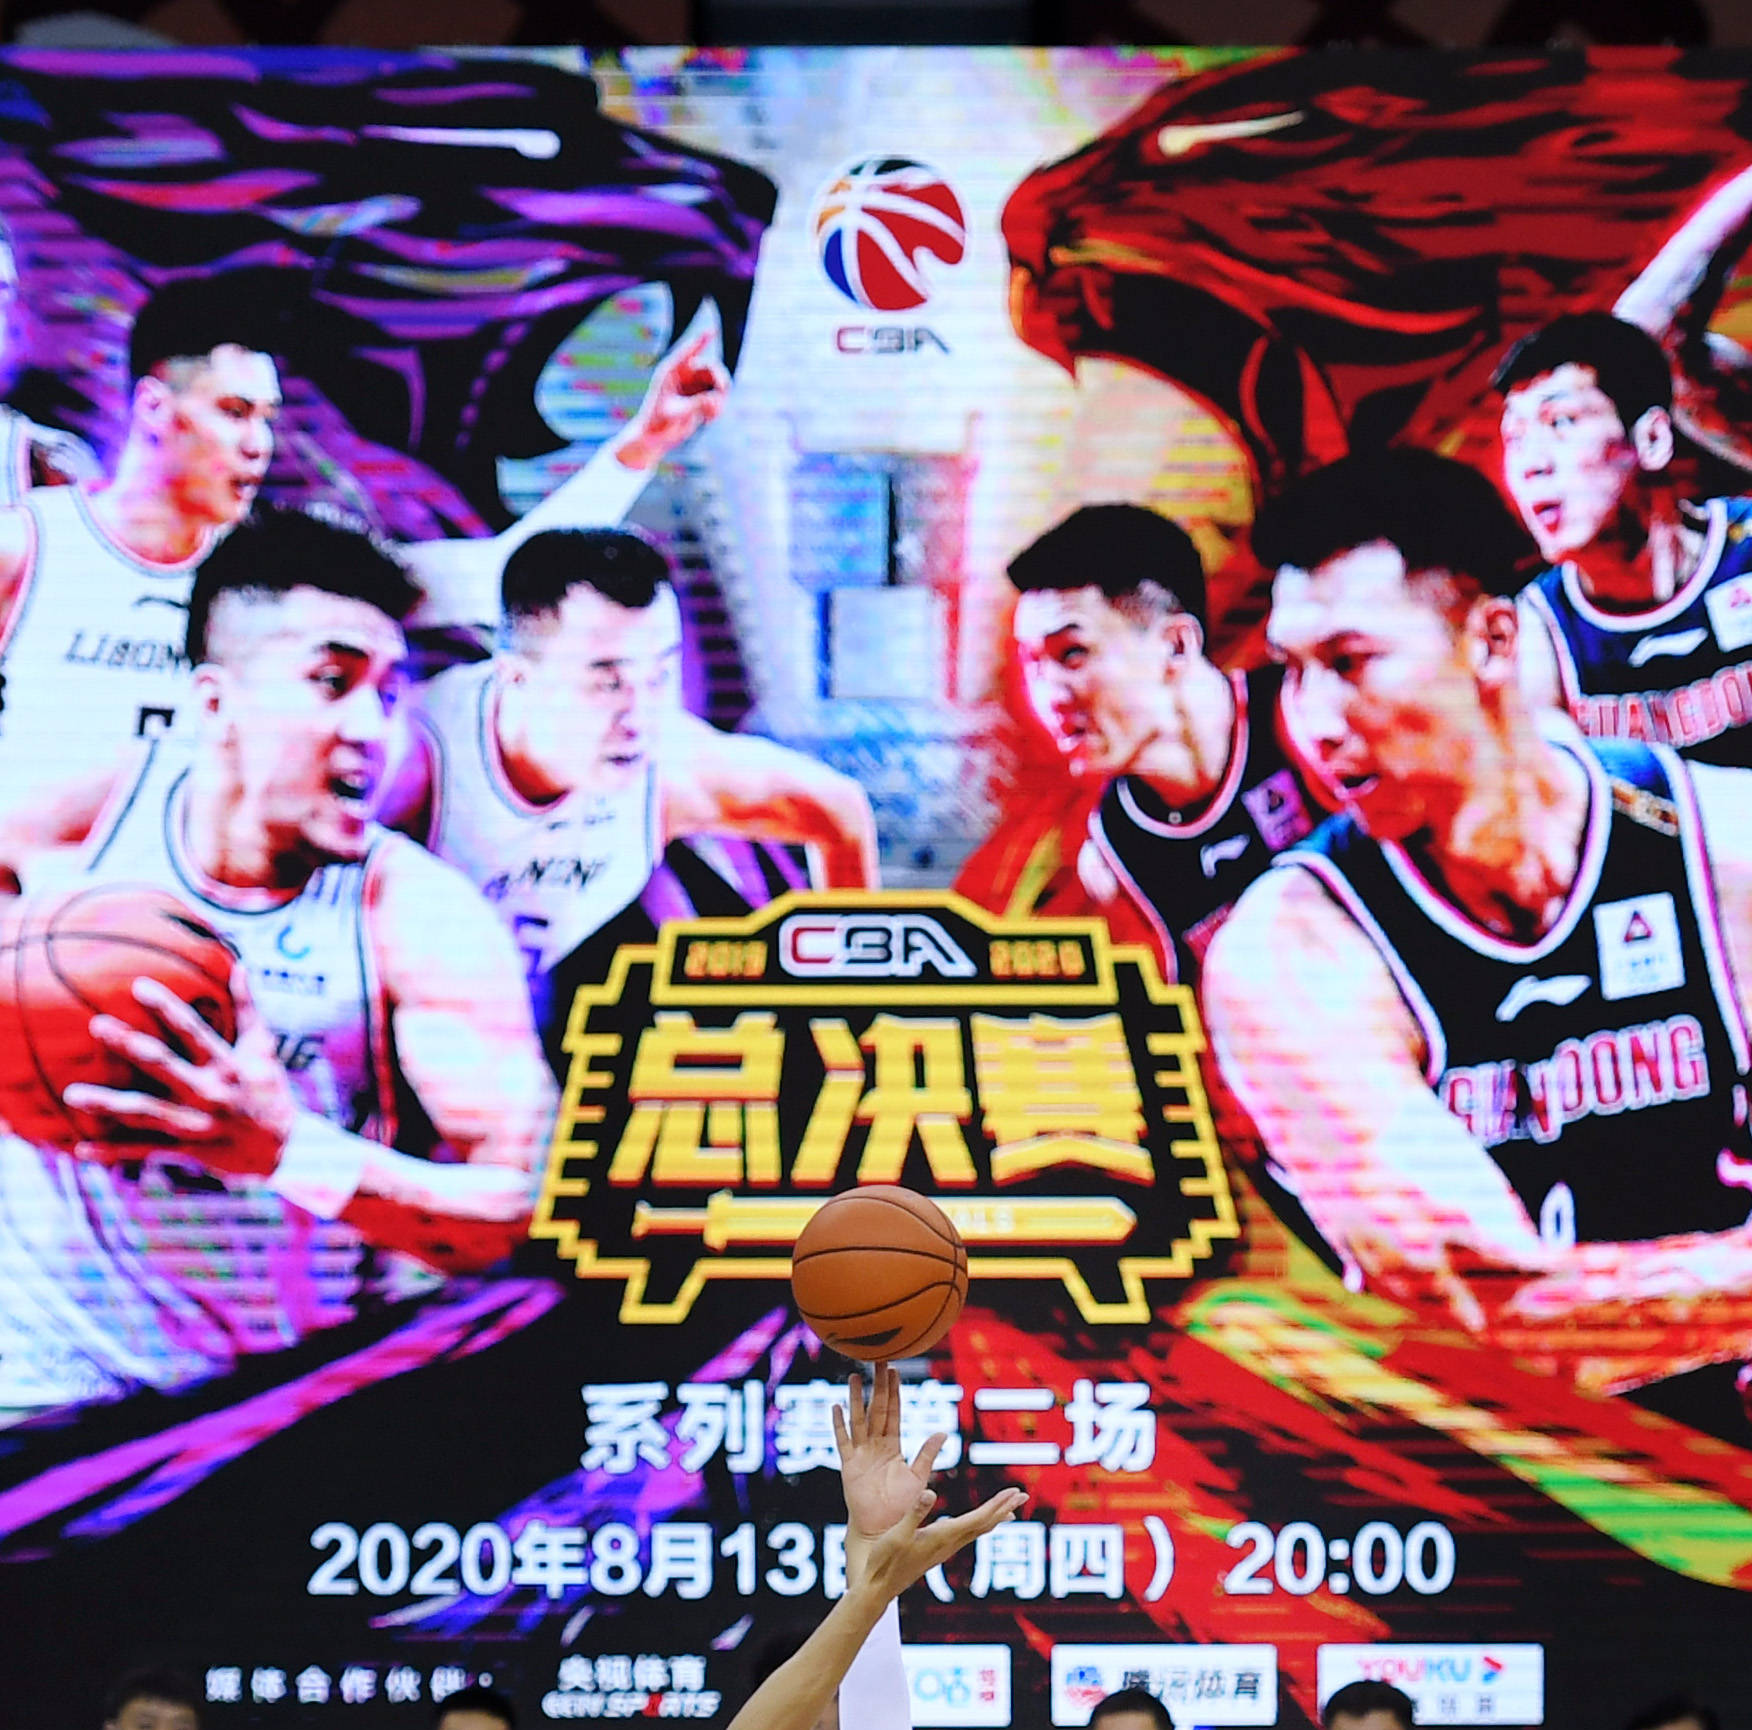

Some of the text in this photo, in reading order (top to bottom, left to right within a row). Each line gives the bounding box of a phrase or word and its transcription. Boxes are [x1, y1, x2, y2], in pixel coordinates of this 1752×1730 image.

[836, 326, 951, 354] CBA
[778, 914, 978, 978] CBA
[989, 940, 1087, 978] 2020
[607, 1010, 1156, 1188] 总决赛
[581, 1379, 1158, 1475] 系列赛第二场
[1224, 1519, 1457, 1599] 20:00
[1354, 1655, 1474, 1685] YOUKU
